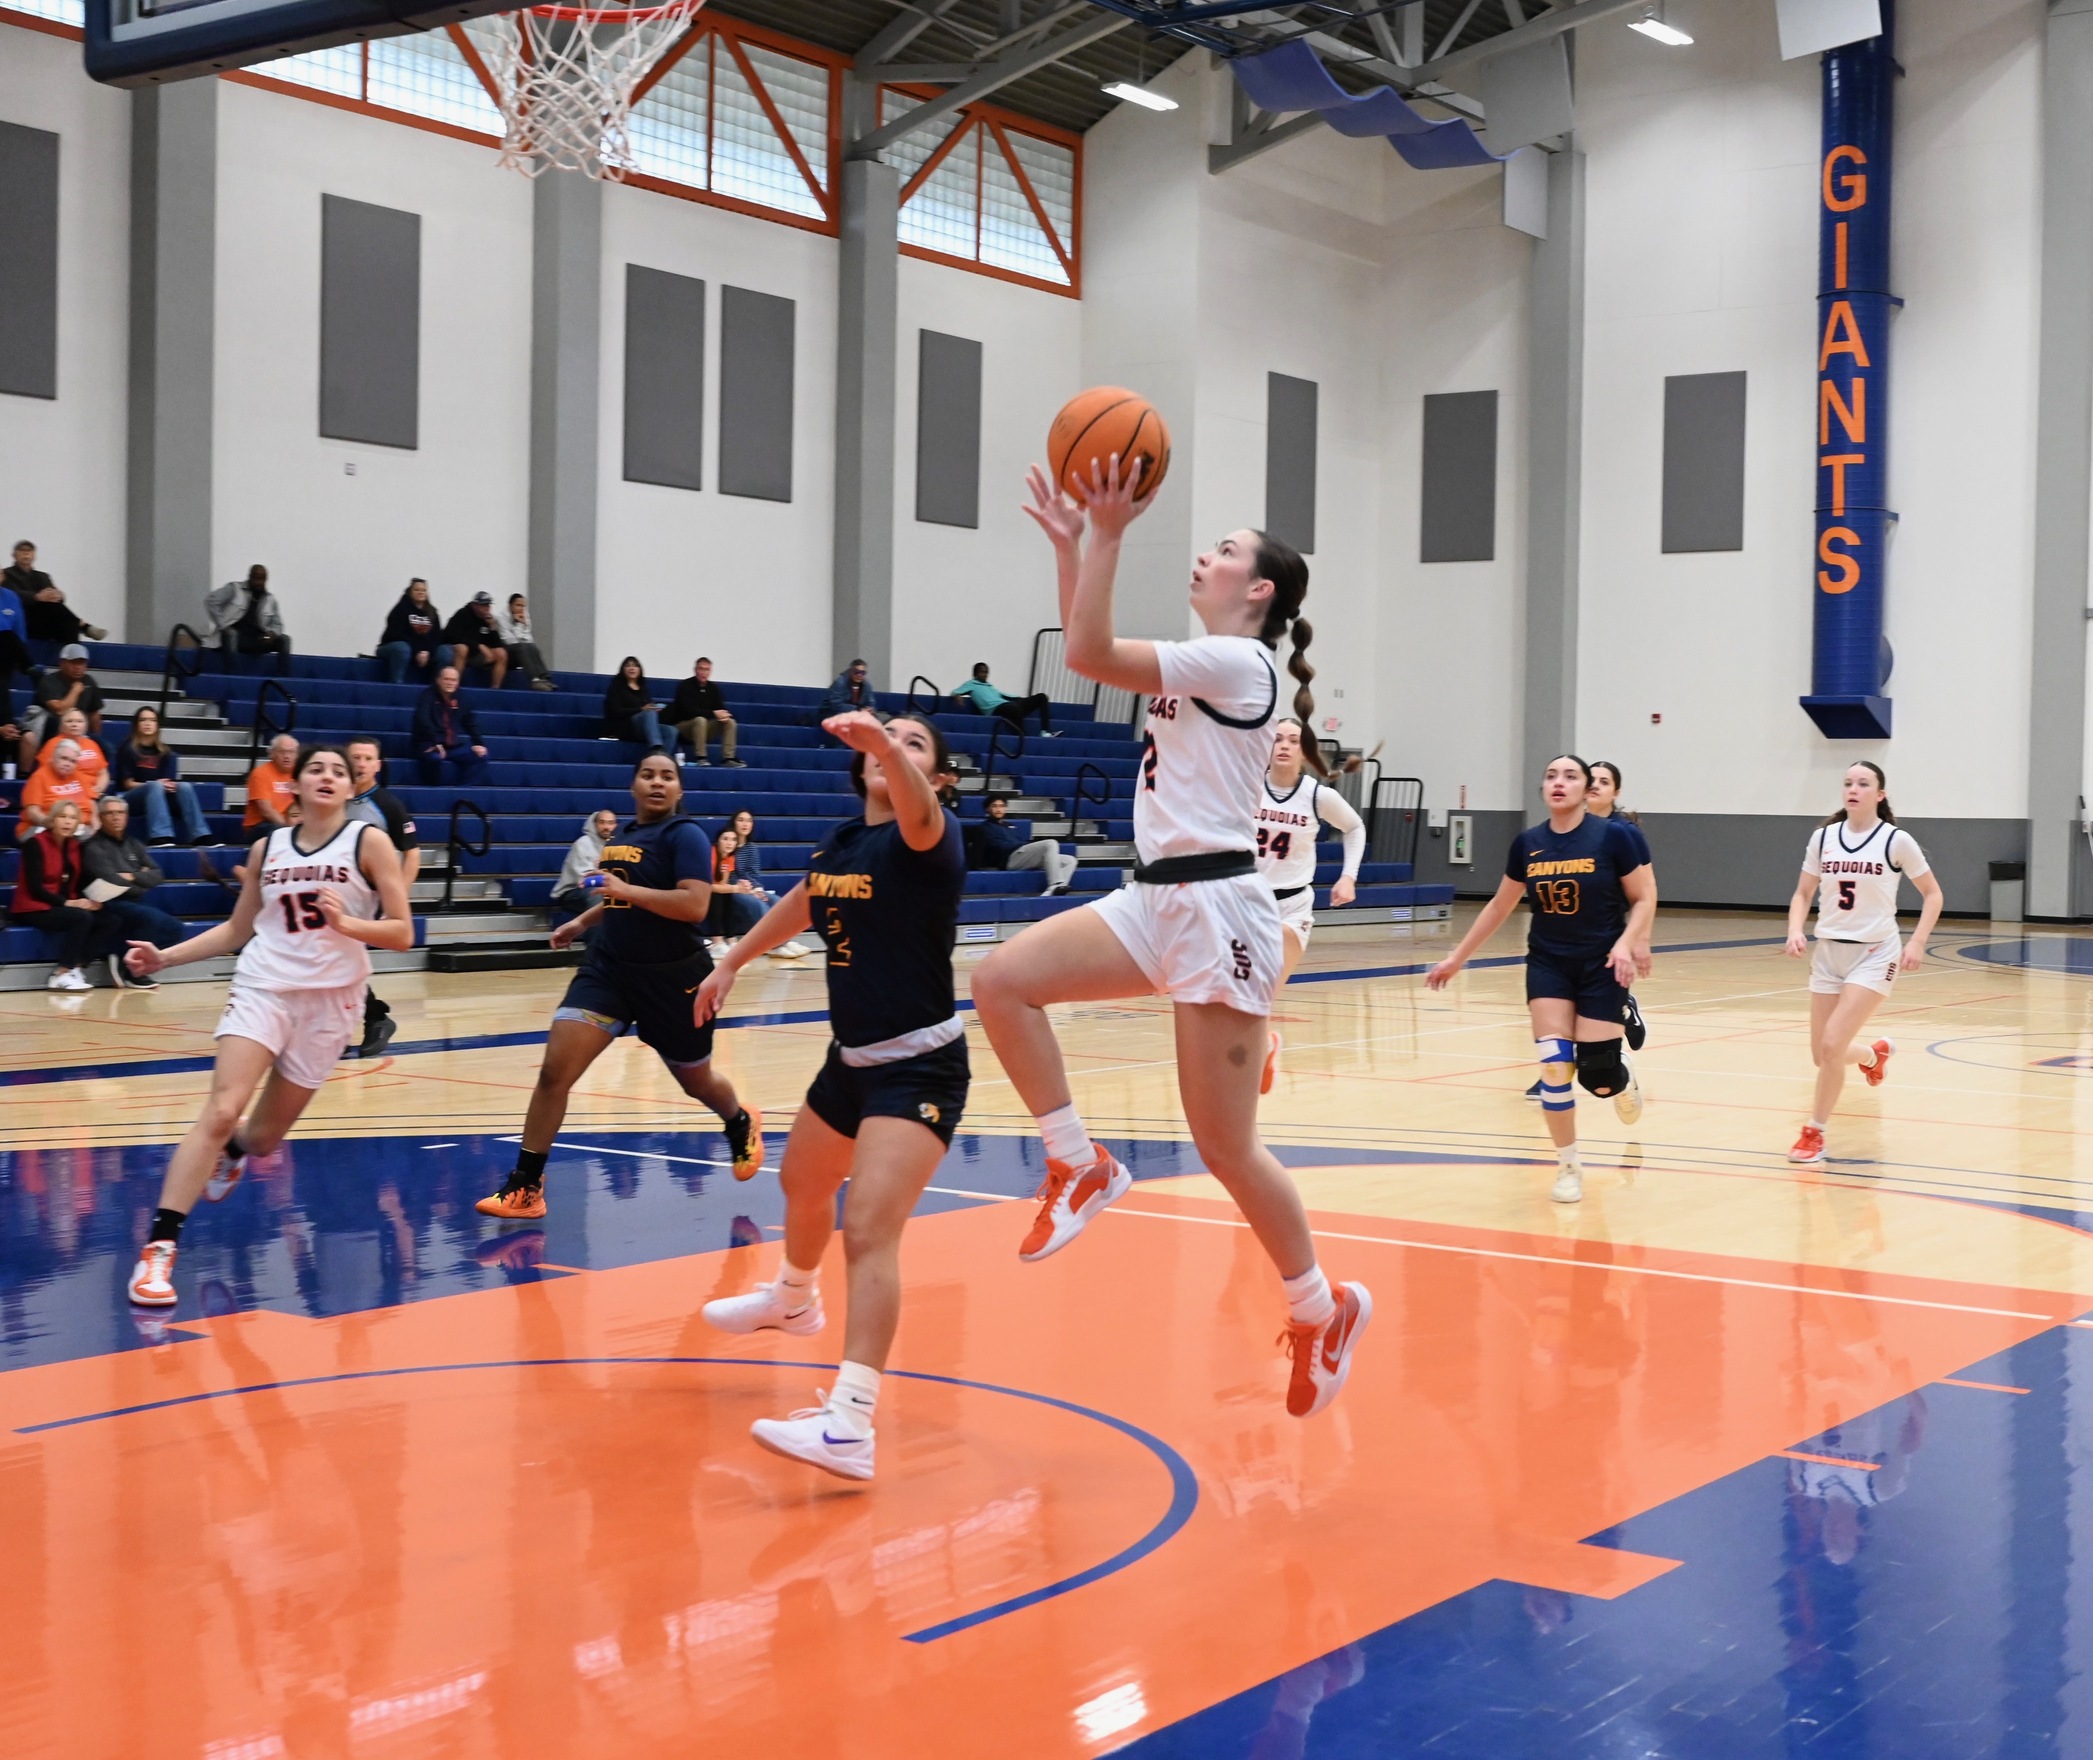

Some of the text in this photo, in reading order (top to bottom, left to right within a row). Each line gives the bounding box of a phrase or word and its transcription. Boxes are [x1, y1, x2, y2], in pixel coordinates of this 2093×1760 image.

[1817, 145, 1870, 595] GIANTS
[1254, 808, 1308, 828] QUOIAS
[1256, 827, 1292, 860] 24
[1526, 858, 1596, 878] CANYONS
[1821, 861, 1884, 876] SEQUOIAS
[1536, 879, 1580, 915] 13
[1838, 880, 1856, 911] 5
[279, 890, 328, 934] 15
